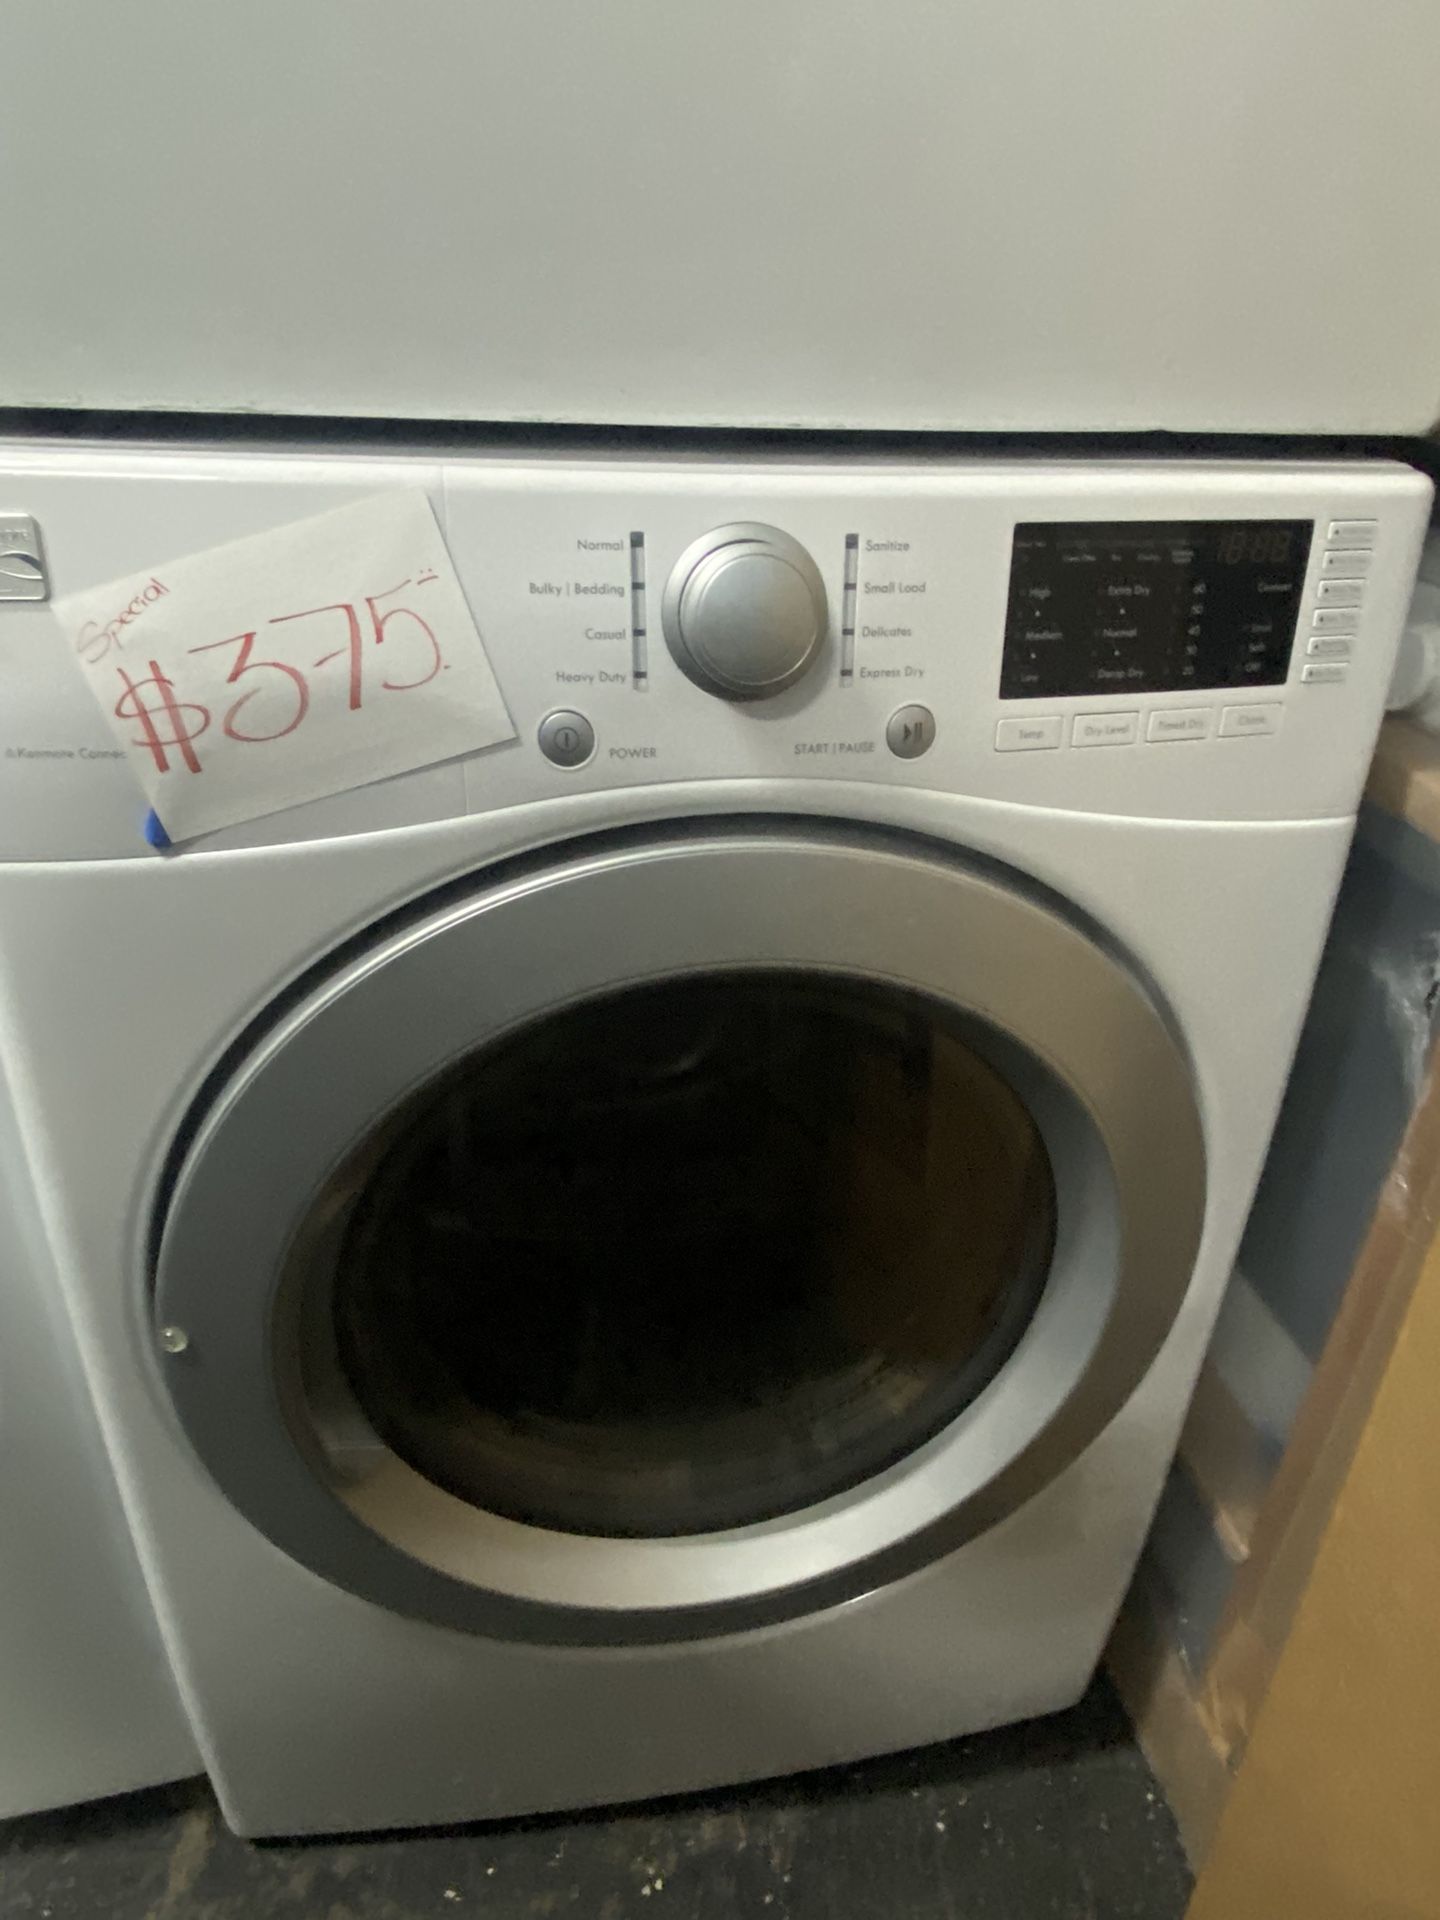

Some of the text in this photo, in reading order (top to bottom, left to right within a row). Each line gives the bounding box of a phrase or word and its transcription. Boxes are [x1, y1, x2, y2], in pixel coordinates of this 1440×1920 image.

[577, 539, 624, 552] Normal
[865, 539, 910, 552] Sanitize
[529, 581, 562, 597] Bulky
[574, 582, 625, 598] Bedding
[864, 581, 926, 594] Small Load
[1133, 585, 1150, 597] Dry
[77, 577, 170, 664] Special
[585, 628, 626, 641] Casual
[862, 625, 912, 638] Delicates
[556, 670, 627, 685] Heavy Duty
[860, 666, 925, 680] Express Dry
[1127, 668, 1145, 680] Dry
[1018, 729, 1045, 741] Temp
[1084, 724, 1130, 737] Dry Level
[78, 746, 128, 760] Connec
[608, 747, 657, 759] POWER
[794, 742, 829, 755] START
[839, 741, 875, 754] PAUSE
